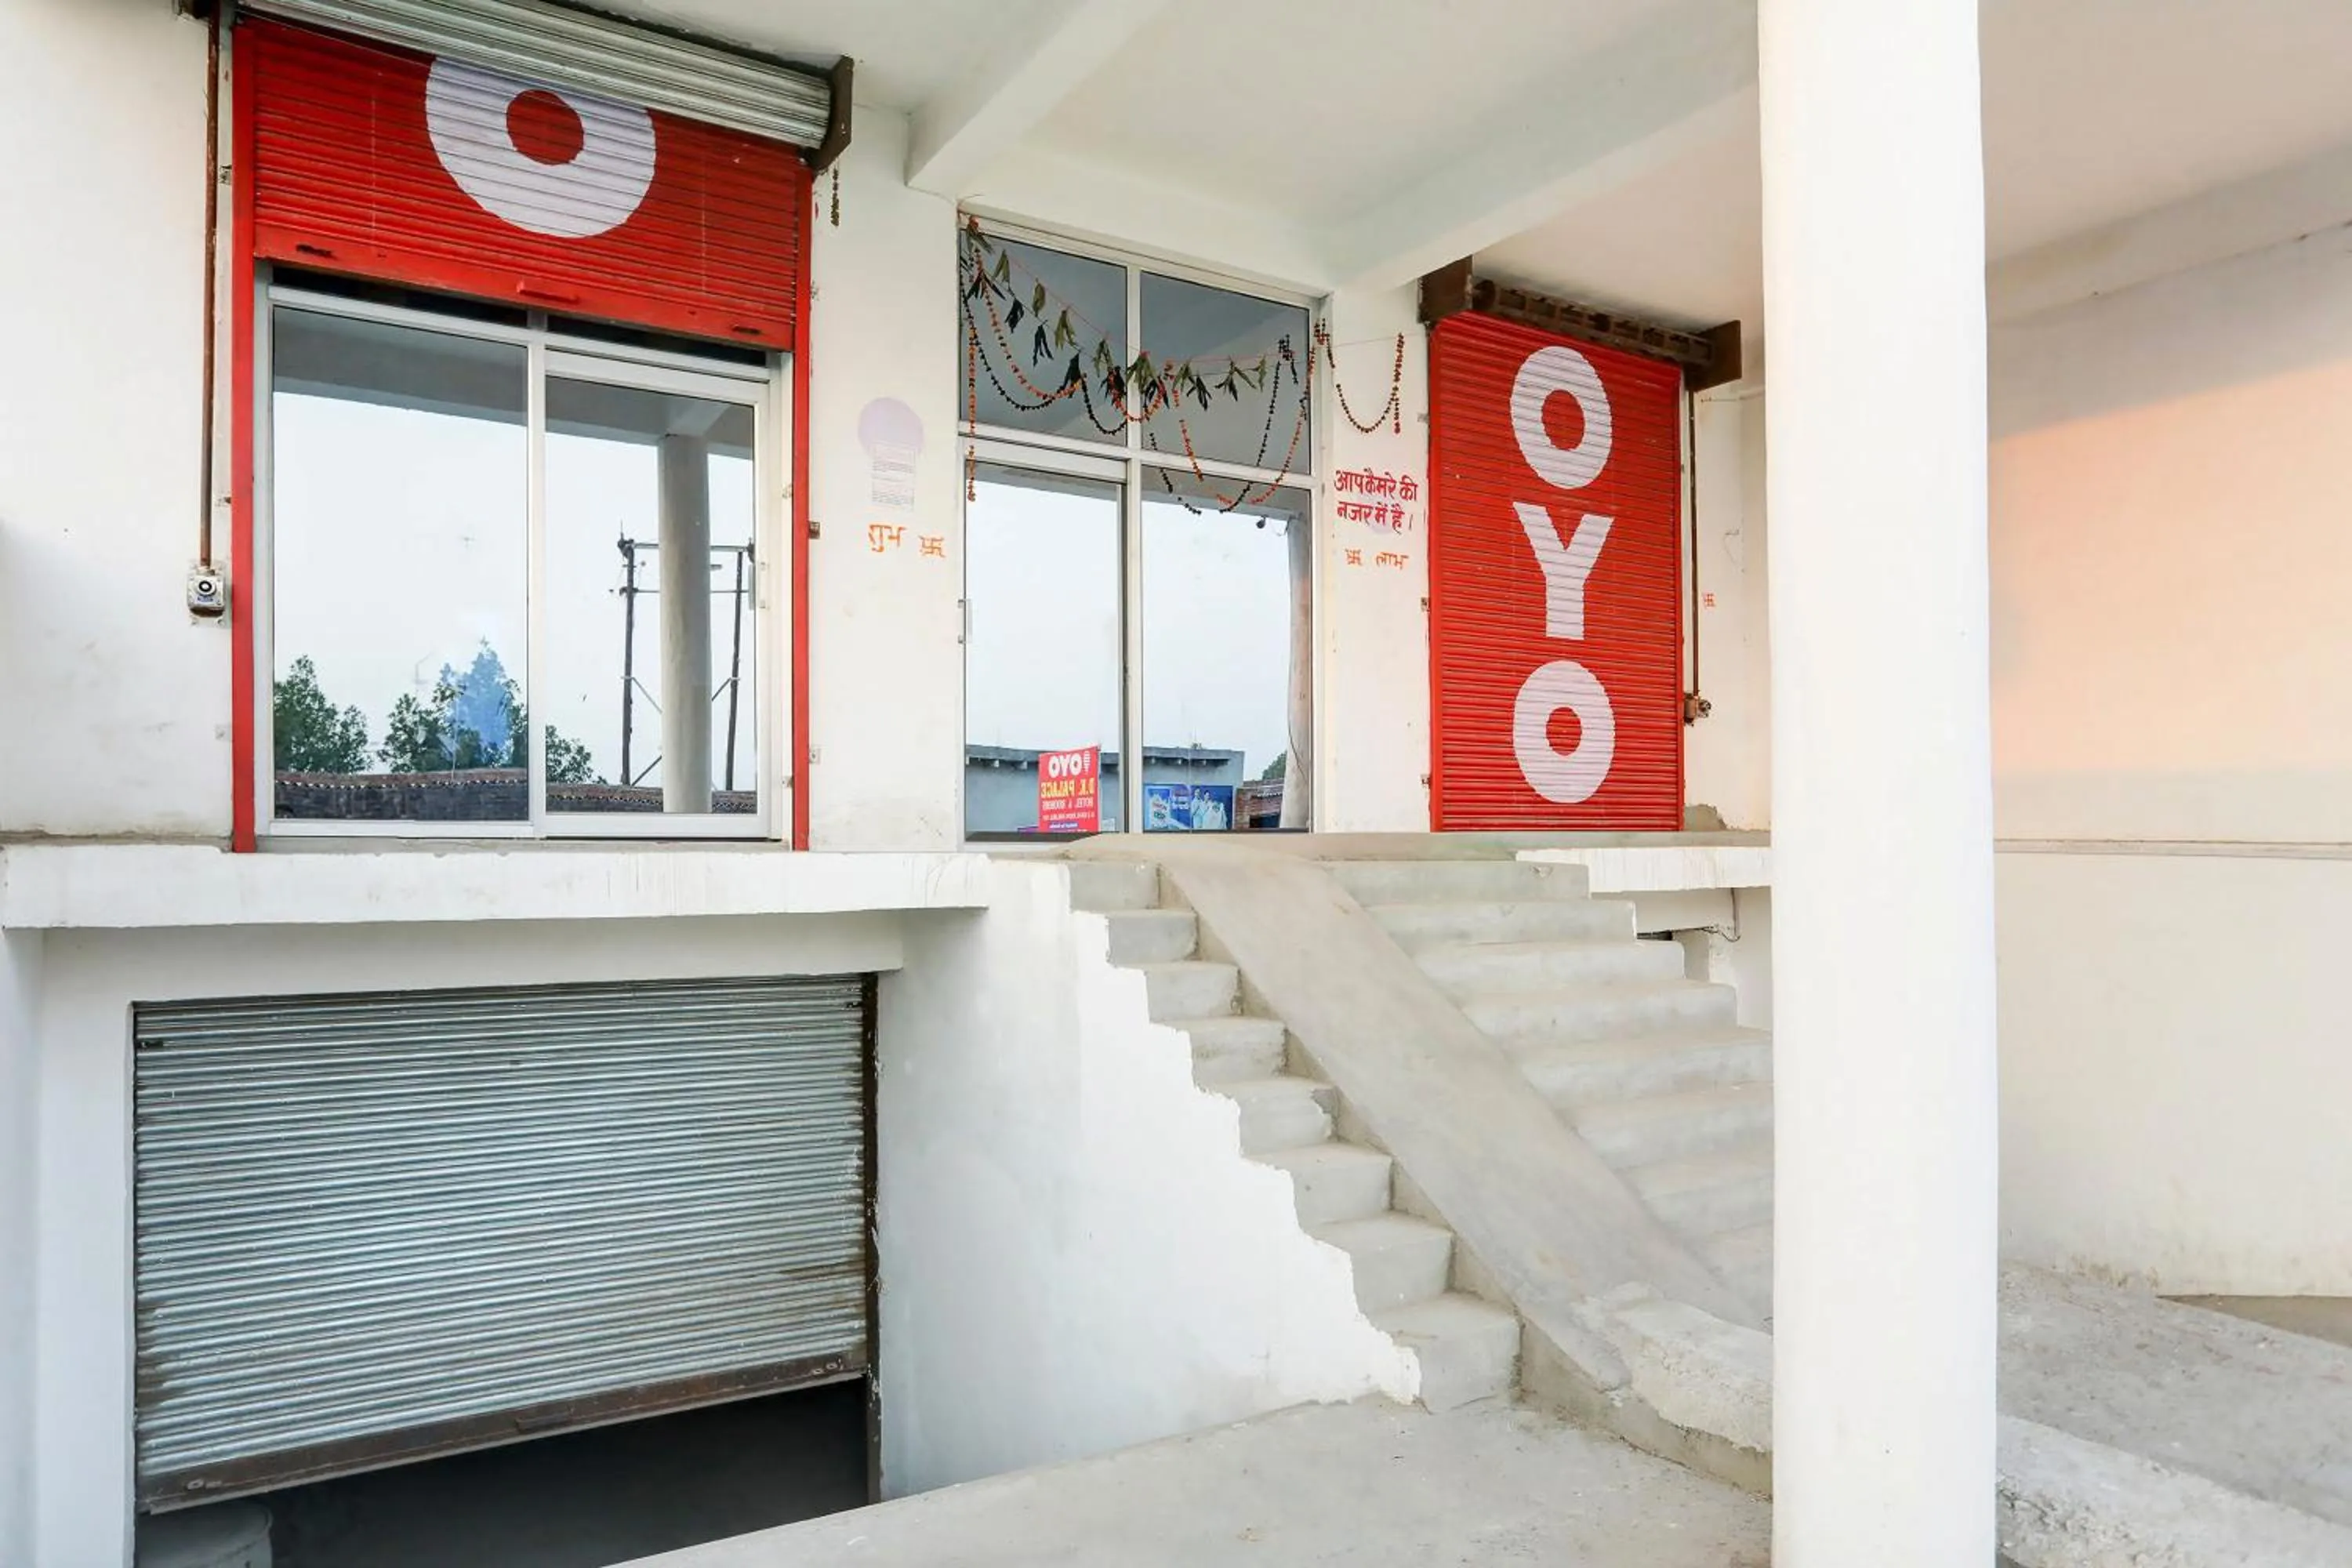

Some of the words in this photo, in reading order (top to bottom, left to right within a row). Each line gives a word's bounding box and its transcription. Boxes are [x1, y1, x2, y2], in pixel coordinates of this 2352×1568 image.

[1399, 474, 1418, 501] की
[1337, 501, 1374, 526] नजर
[1510, 346, 1615, 804] OYO
